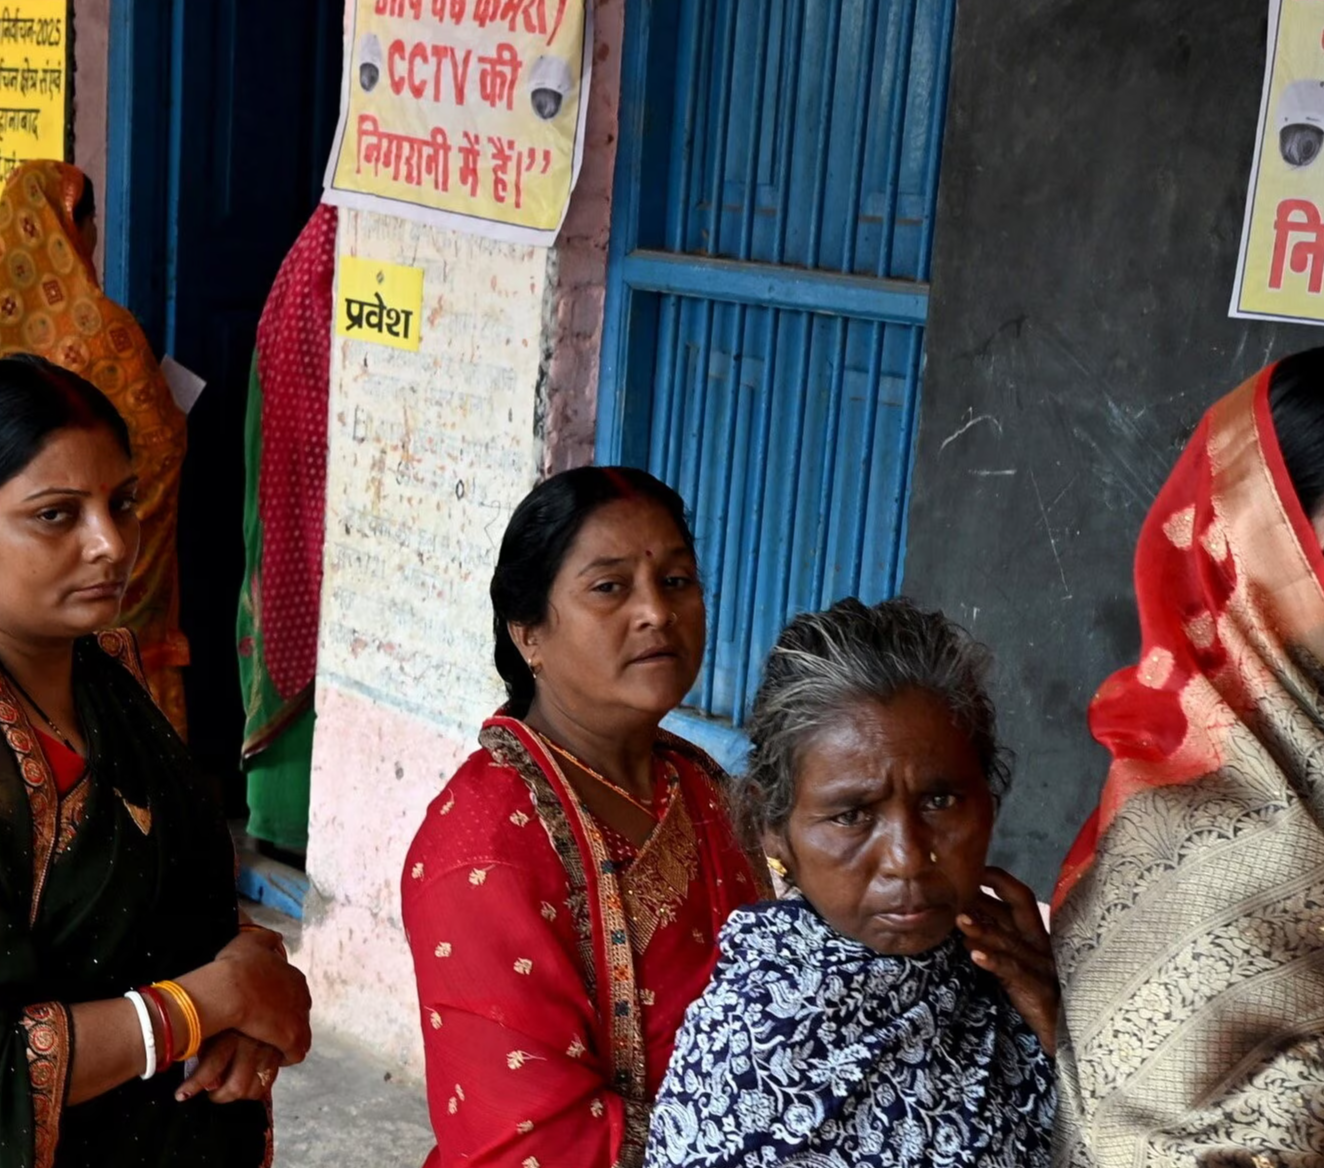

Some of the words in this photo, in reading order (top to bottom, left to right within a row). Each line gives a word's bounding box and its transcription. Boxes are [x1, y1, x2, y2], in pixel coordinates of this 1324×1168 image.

[387, 39, 472, 106] CCTV
[477, 43, 522, 111] की
[355, 114, 451, 192] निगरानी
[459, 131, 481, 198] में
[344, 291, 413, 340] प्रवेश
